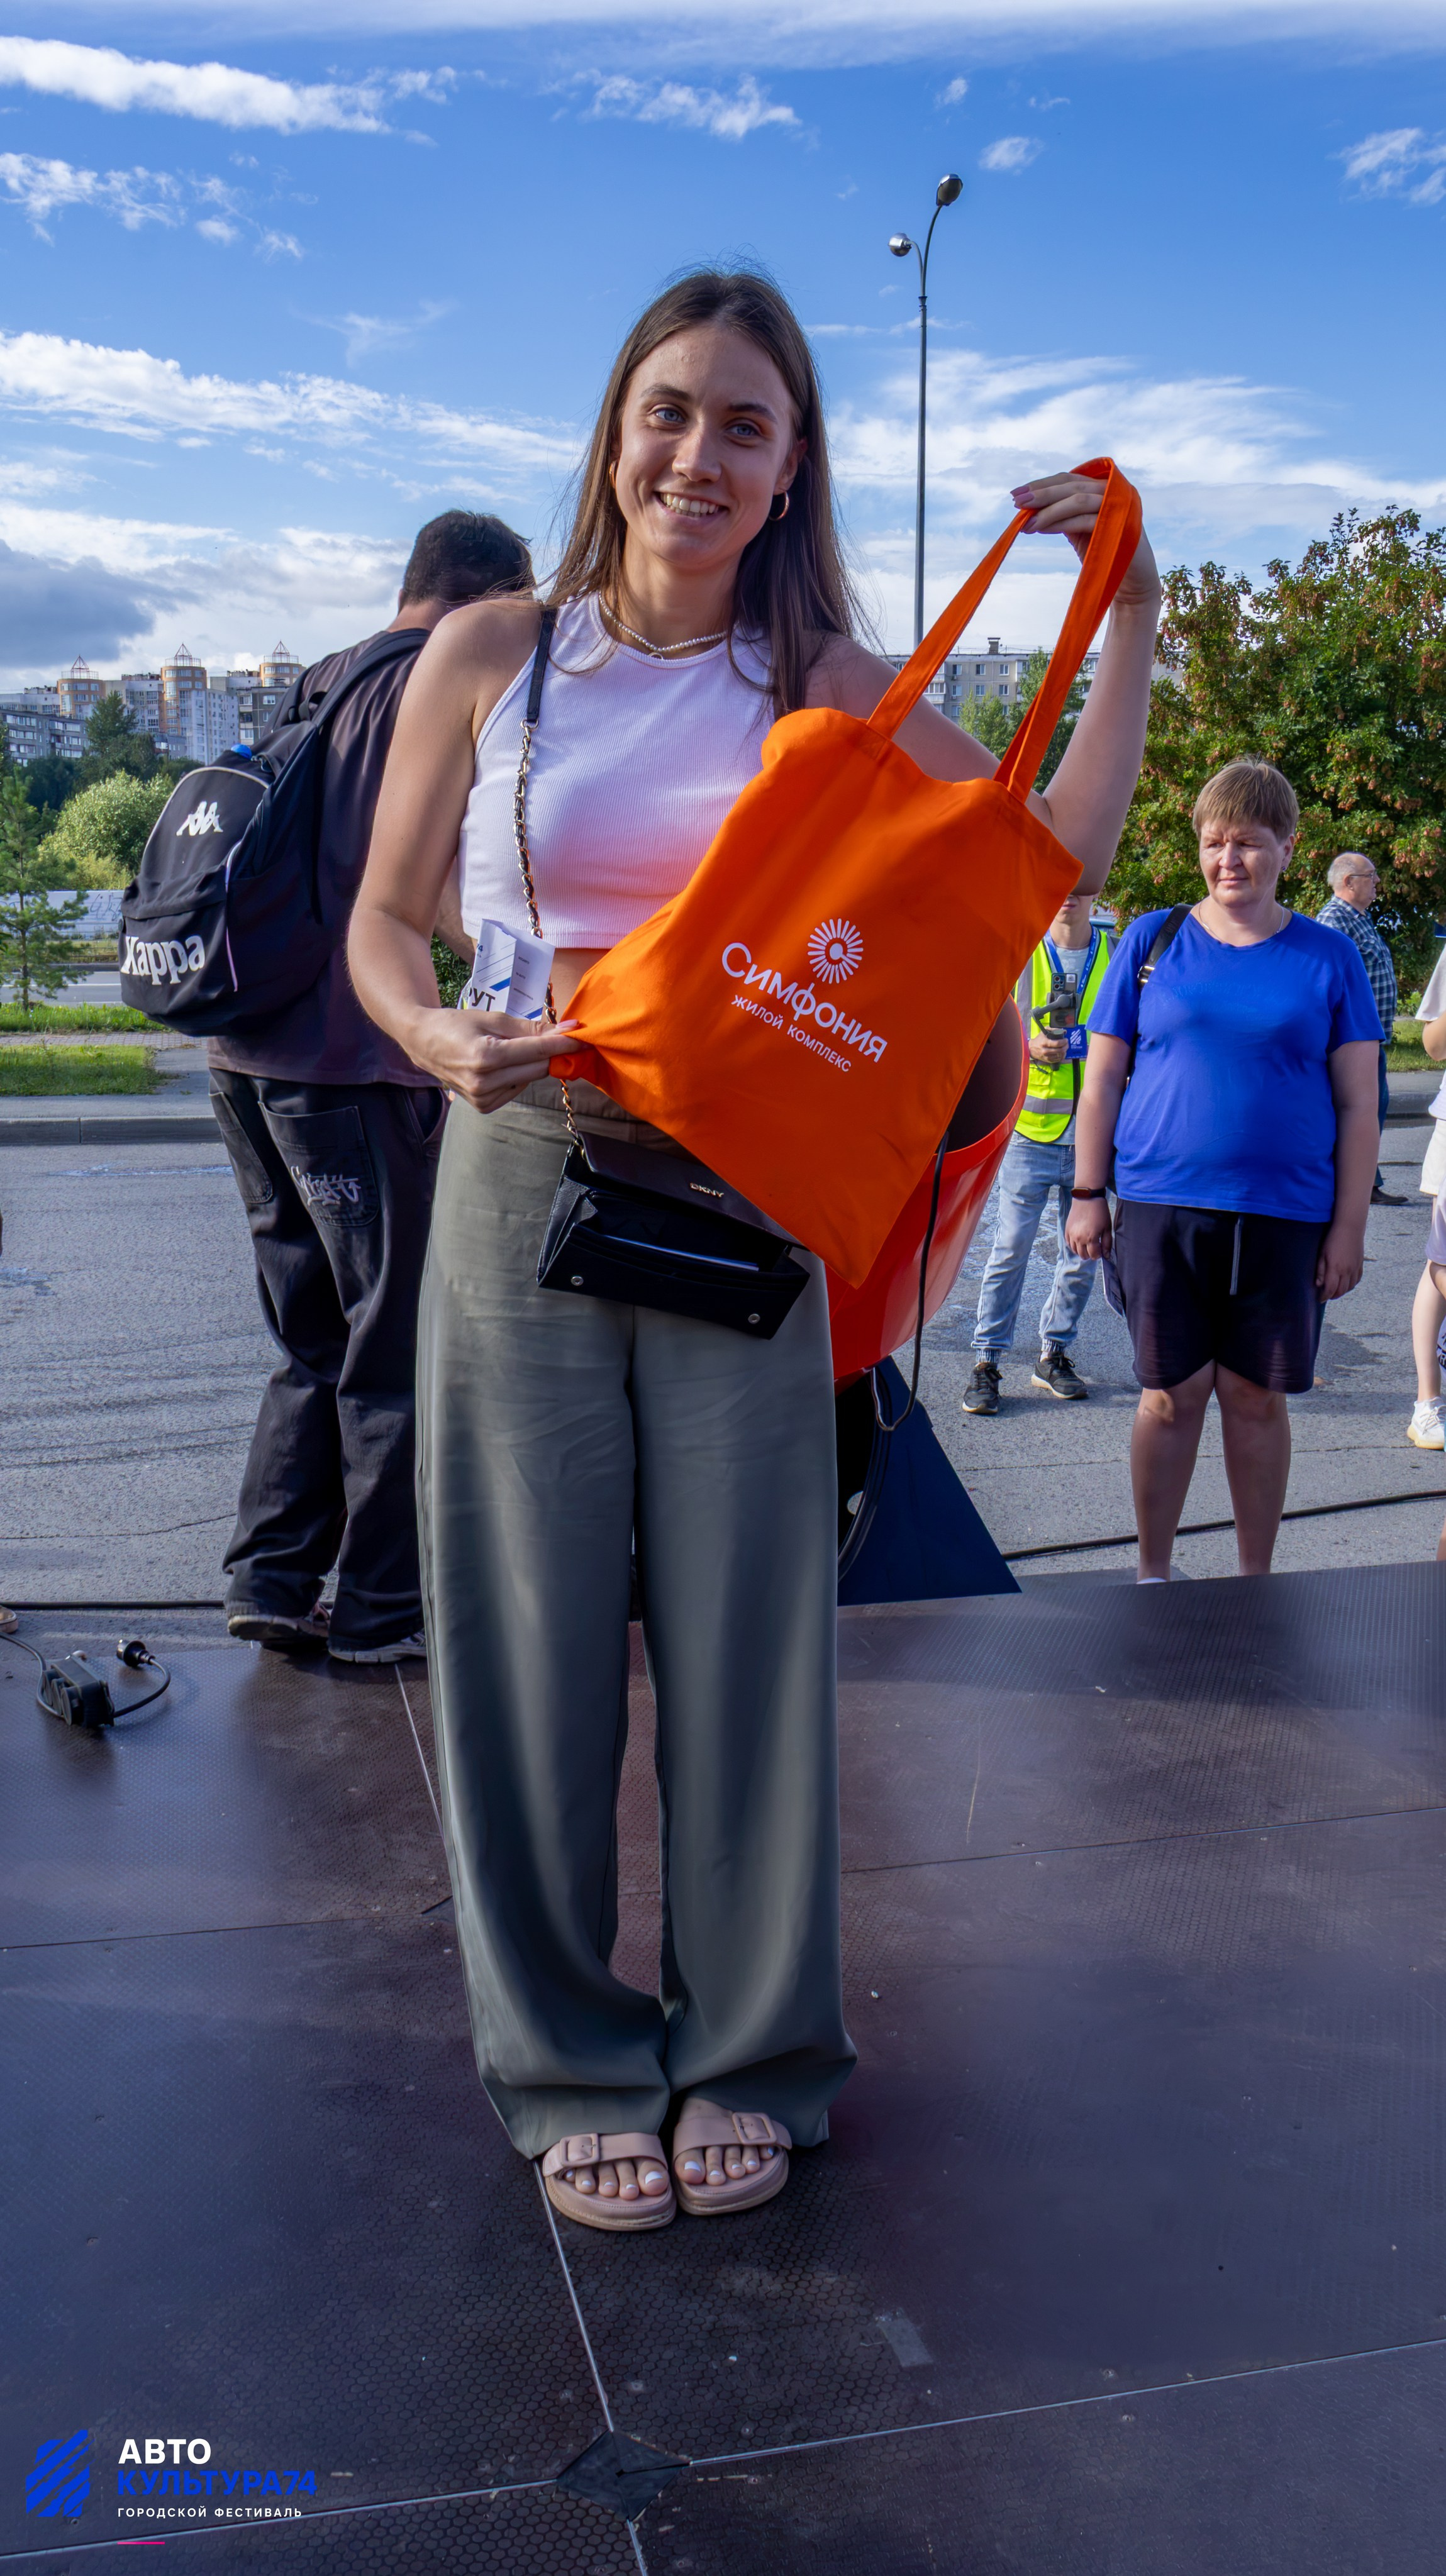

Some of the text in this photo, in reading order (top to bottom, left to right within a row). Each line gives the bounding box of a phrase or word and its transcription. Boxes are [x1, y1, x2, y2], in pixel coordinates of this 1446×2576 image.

[120, 935, 205, 985] Kappa
[469, 987, 496, 1012] УТ
[721, 941, 888, 1063] Симфония
[731, 994, 852, 1072] ЖИЛОЙ КОМПЛЕКС
[689, 1182, 725, 1198] DKNY
